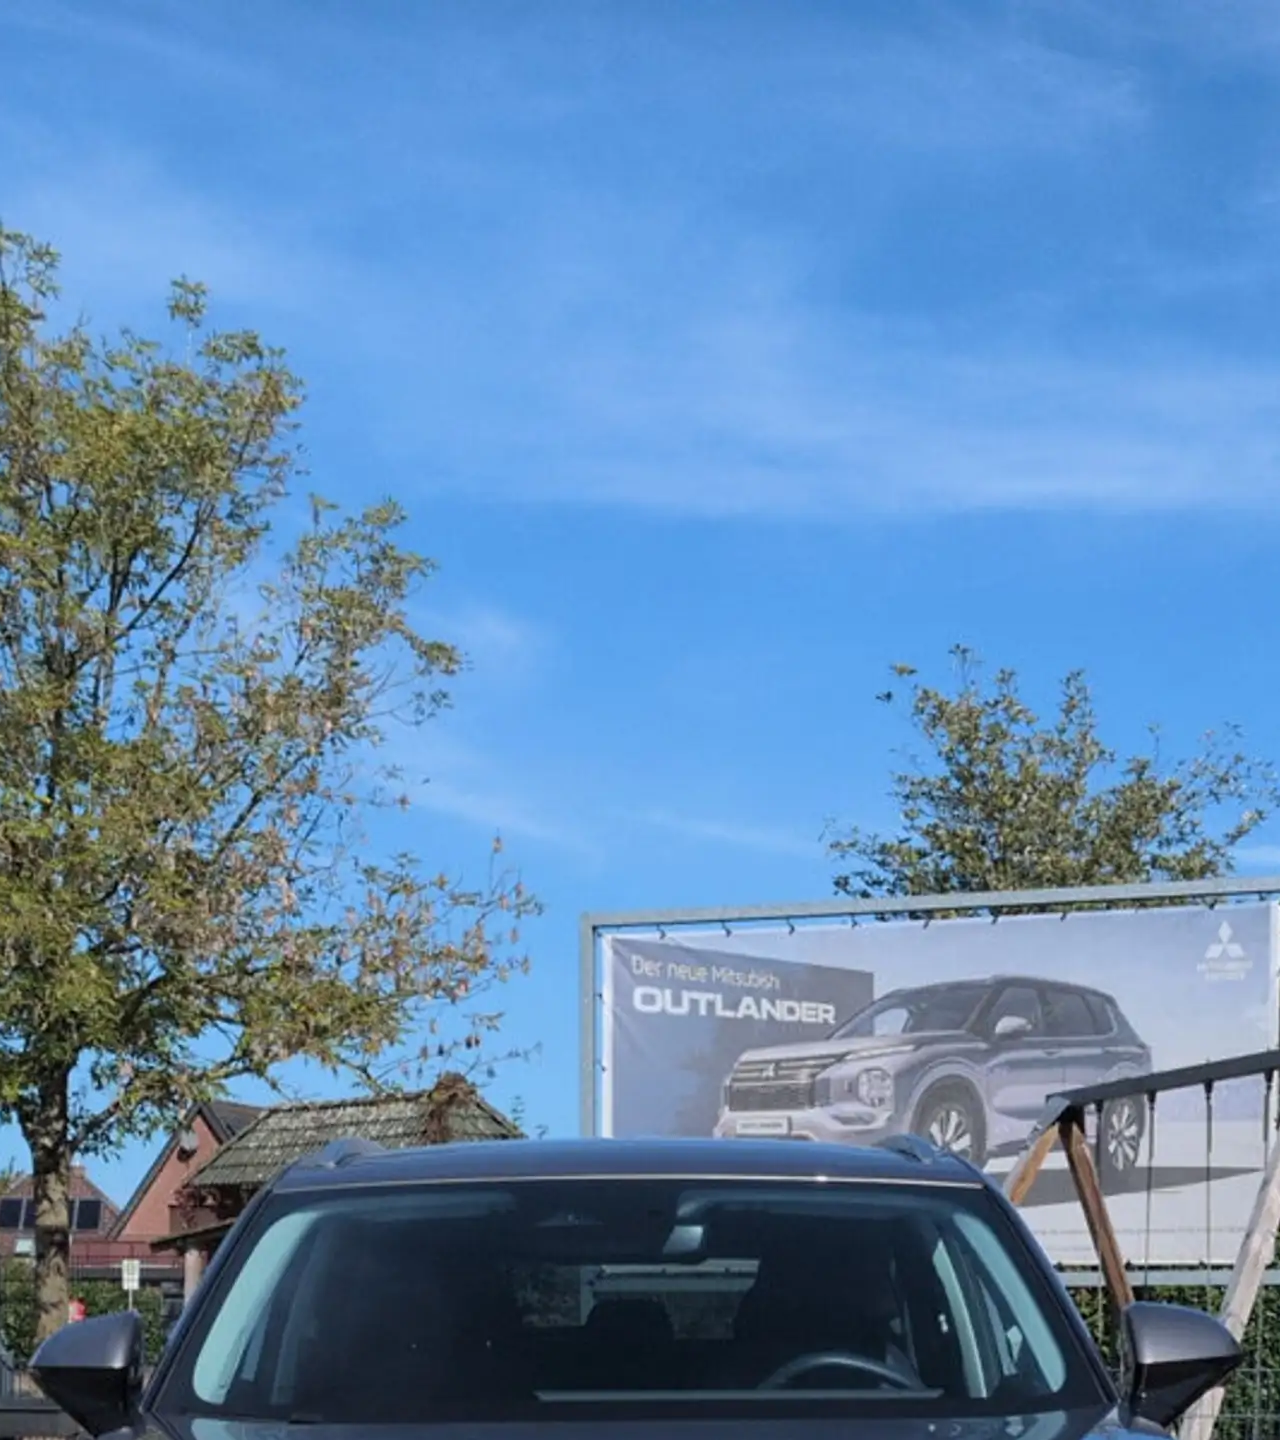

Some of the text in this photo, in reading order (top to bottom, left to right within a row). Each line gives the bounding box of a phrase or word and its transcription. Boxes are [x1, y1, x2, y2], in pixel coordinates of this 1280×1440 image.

[631, 955, 661, 976] Der
[667, 962, 708, 983] neue
[632, 986, 836, 1025] OUTLANDER
